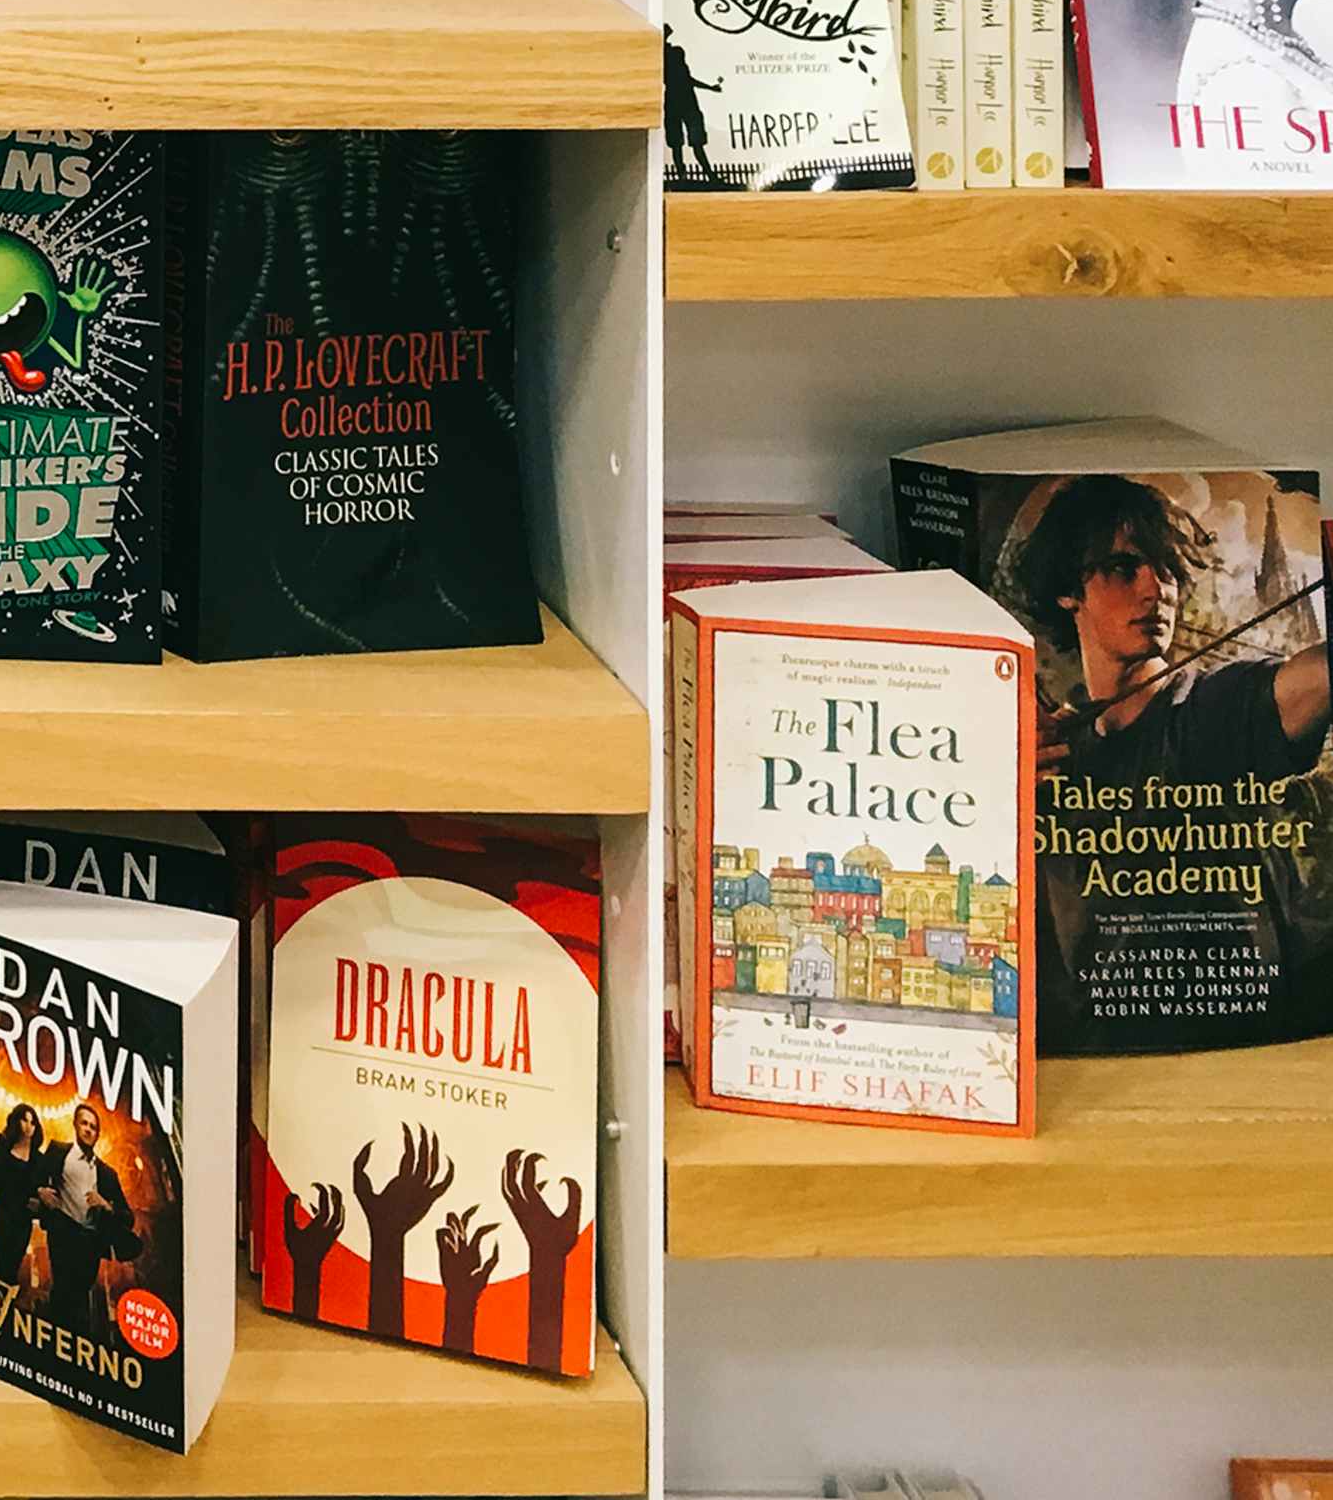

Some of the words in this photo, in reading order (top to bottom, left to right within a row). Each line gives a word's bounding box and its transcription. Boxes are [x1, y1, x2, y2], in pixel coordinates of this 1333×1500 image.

[223, 340, 287, 402] H.P.
[294, 329, 491, 390] LOVECRAFT
[280, 392, 433, 440] Collection
[772, 710, 816, 738] The
[822, 698, 964, 765] Flea
[758, 755, 978, 828] Palace
[1044, 775, 1137, 811] Tales
[1142, 778, 1223, 808] from
[1233, 773, 1287, 805] the
[1033, 818, 1314, 856] Shadowhunter
[1081, 859, 1264, 904] Academy
[1094, 949, 1201, 965] CASSANDRA
[1207, 946, 1262, 961] CLARE
[334, 958, 533, 1074] DRACULA
[356, 1067, 415, 1095] BRAM
[424, 1079, 508, 1111] STOKER
